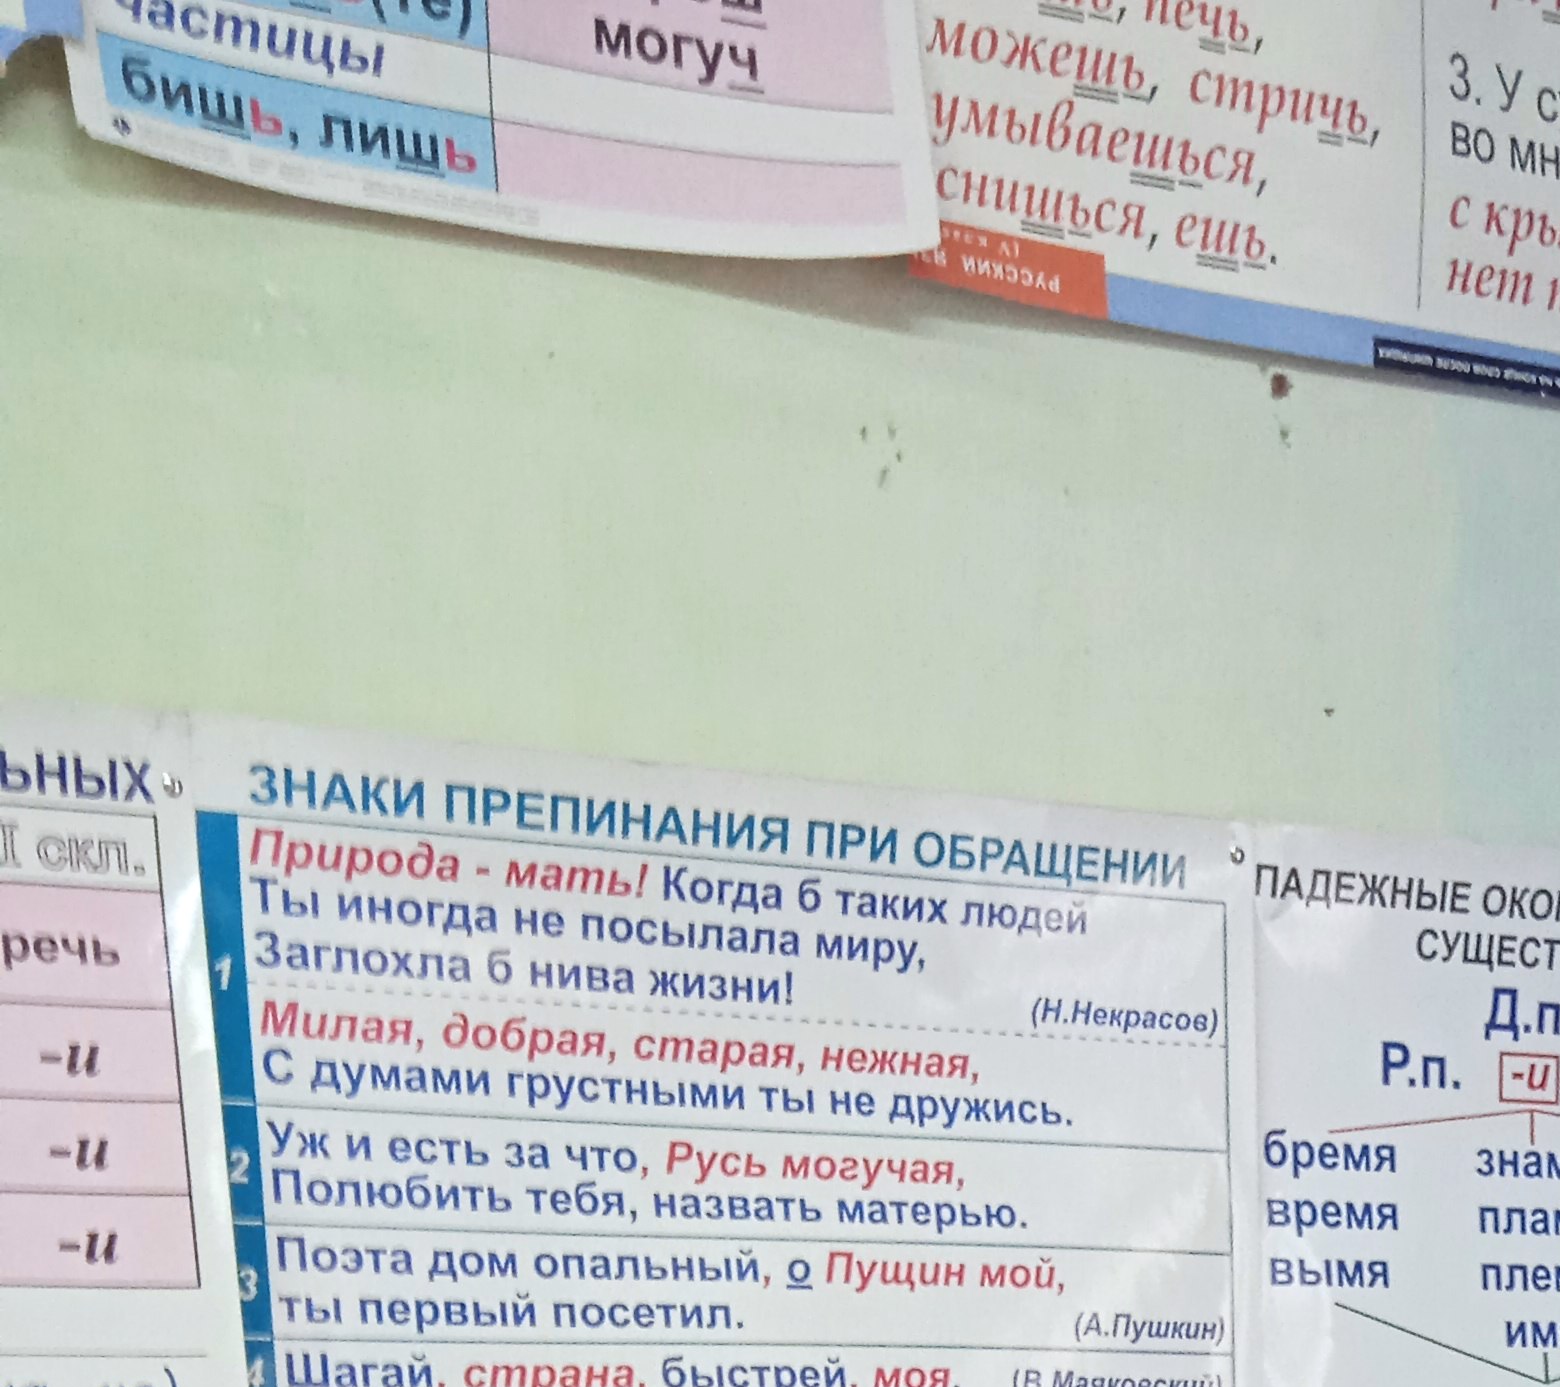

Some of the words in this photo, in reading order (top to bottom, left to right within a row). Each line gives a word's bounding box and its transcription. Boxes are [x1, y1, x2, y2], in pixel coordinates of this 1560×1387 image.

[595, 17, 764, 93] могуч
[926, 17, 1158, 102] можешь,
[1189, 68, 1379, 147] стричь,
[1449, 52, 1481, 106] 3.
[1495, 63, 1524, 113] У
[122, 54, 299, 151] бишь,
[319, 113, 478, 179] лишь
[1451, 119, 1495, 164] во
[931, 92, 1268, 196] умываешься,
[936, 166, 1160, 250] снишься,
[1175, 213, 1277, 269] ешь.
[1449, 195, 1471, 230] с
[1446, 253, 1533, 307] нет
[249, 763, 425, 820] ЗНАКИ
[445, 783, 789, 855] ПРЕПИНАНИЯ
[806, 818, 898, 865] ПРИ
[913, 831, 1187, 890] ОБРАЩЕНИИ
[37, 834, 147, 877] скл.
[250, 826, 459, 883] Природа
[505, 859, 648, 898] мать!
[662, 865, 783, 915] Когда
[798, 878, 822, 913] б
[836, 889, 949, 927] таких
[961, 899, 1088, 938] людей
[1255, 862, 1472, 915] ПАДЕЖНЫЕ
[1, 929, 121, 971] речь
[250, 876, 320, 920] Ты
[338, 890, 498, 938] иногда
[515, 902, 565, 939] не
[581, 911, 800, 958] посылала
[816, 931, 926, 974] миру,
[214, 952, 233, 993] 1
[255, 930, 471, 983] Заглохла
[487, 949, 513, 985] б
[529, 961, 634, 995] нива
[648, 970, 795, 1006] жизни!
[260, 999, 425, 1051] Милая,
[442, 1013, 618, 1064] добрая,
[634, 1032, 806, 1074] старая,
[820, 1044, 980, 1086] нежная,
[1030, 996, 1220, 1040] (Н.Некрасов)
[262, 1048, 294, 1086] С
[310, 1058, 491, 1099] думами
[507, 1070, 744, 1110] грустными
[759, 1085, 815, 1116] ты
[830, 1090, 876, 1118] не
[888, 1093, 1073, 1130] дружись.
[1381, 1041, 1461, 1090] Р.п.
[230, 1151, 250, 1185] 2
[266, 1119, 331, 1161] Уж
[345, 1134, 372, 1162] и
[388, 1136, 489, 1168] есть
[504, 1142, 551, 1170] за
[565, 1145, 650, 1180] что,
[665, 1140, 767, 1184] Русь
[781, 1152, 966, 1192] могучая,
[1263, 1129, 1397, 1179] бремя
[271, 1167, 512, 1214] Полюбить
[526, 1182, 638, 1223] тебя,
[654, 1192, 822, 1223] назвать
[837, 1199, 1029, 1235] матерью.
[1266, 1198, 1400, 1237] время
[238, 1266, 259, 1301] 3
[276, 1235, 414, 1277] Поэта
[427, 1250, 518, 1284] дом
[533, 1246, 772, 1290] опальный,
[786, 1257, 813, 1290] о
[825, 1250, 965, 1294] Пущин
[979, 1256, 1066, 1297] мой,
[1270, 1258, 1391, 1289] вымя
[278, 1294, 343, 1325] ты
[358, 1292, 537, 1334] первый
[553, 1298, 745, 1331] посетил.
[1074, 1311, 1226, 1347] (А.Пушкин)
